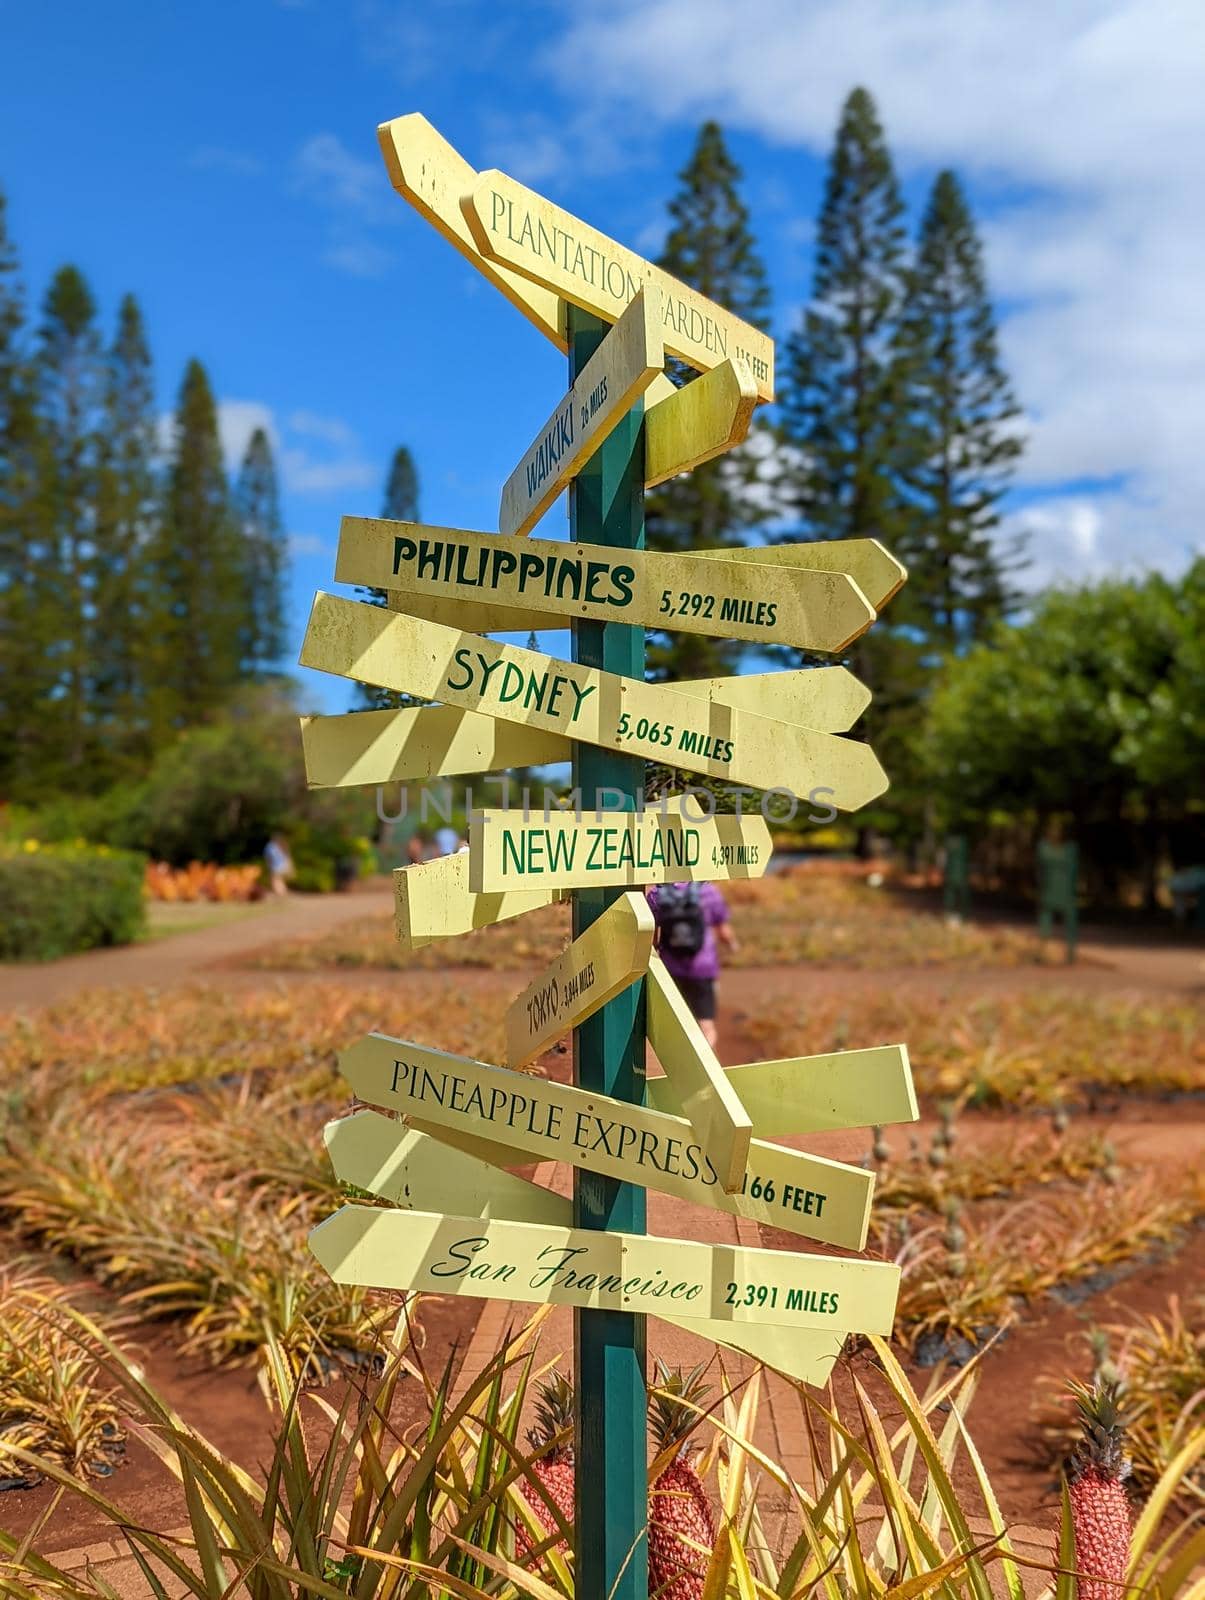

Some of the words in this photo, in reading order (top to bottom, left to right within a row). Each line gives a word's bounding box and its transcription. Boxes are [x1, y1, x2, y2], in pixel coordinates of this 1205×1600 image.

[491, 190, 642, 303] PLANTATION
[661, 290, 727, 356] ARDEN
[753, 356, 768, 382] FEET
[527, 402, 574, 498] WAIKIKI
[581, 403, 589, 430] 26
[590, 376, 608, 418] MILES
[393, 537, 635, 607] PHILIPPINES
[660, 590, 715, 618] 5,292
[720, 597, 778, 627] MILES
[447, 649, 596, 722] SYDNEY
[617, 713, 674, 746] 5,065
[678, 729, 734, 762] MILES
[502, 828, 578, 876] NEW
[586, 828, 700, 871] ZEALAND
[711, 845, 734, 869] 4,391
[737, 845, 759, 865] MILES
[527, 976, 559, 1036] TOKYO
[579, 961, 595, 995] MILES
[389, 1059, 563, 1140] PINEAPPLE
[572, 1112, 718, 1185] EXPRESS
[782, 1184, 827, 1218] FEET
[430, 1237, 517, 1283] San
[529, 1244, 704, 1301] Francisco
[725, 1282, 778, 1309] 2,391
[785, 1288, 839, 1314] MILES
